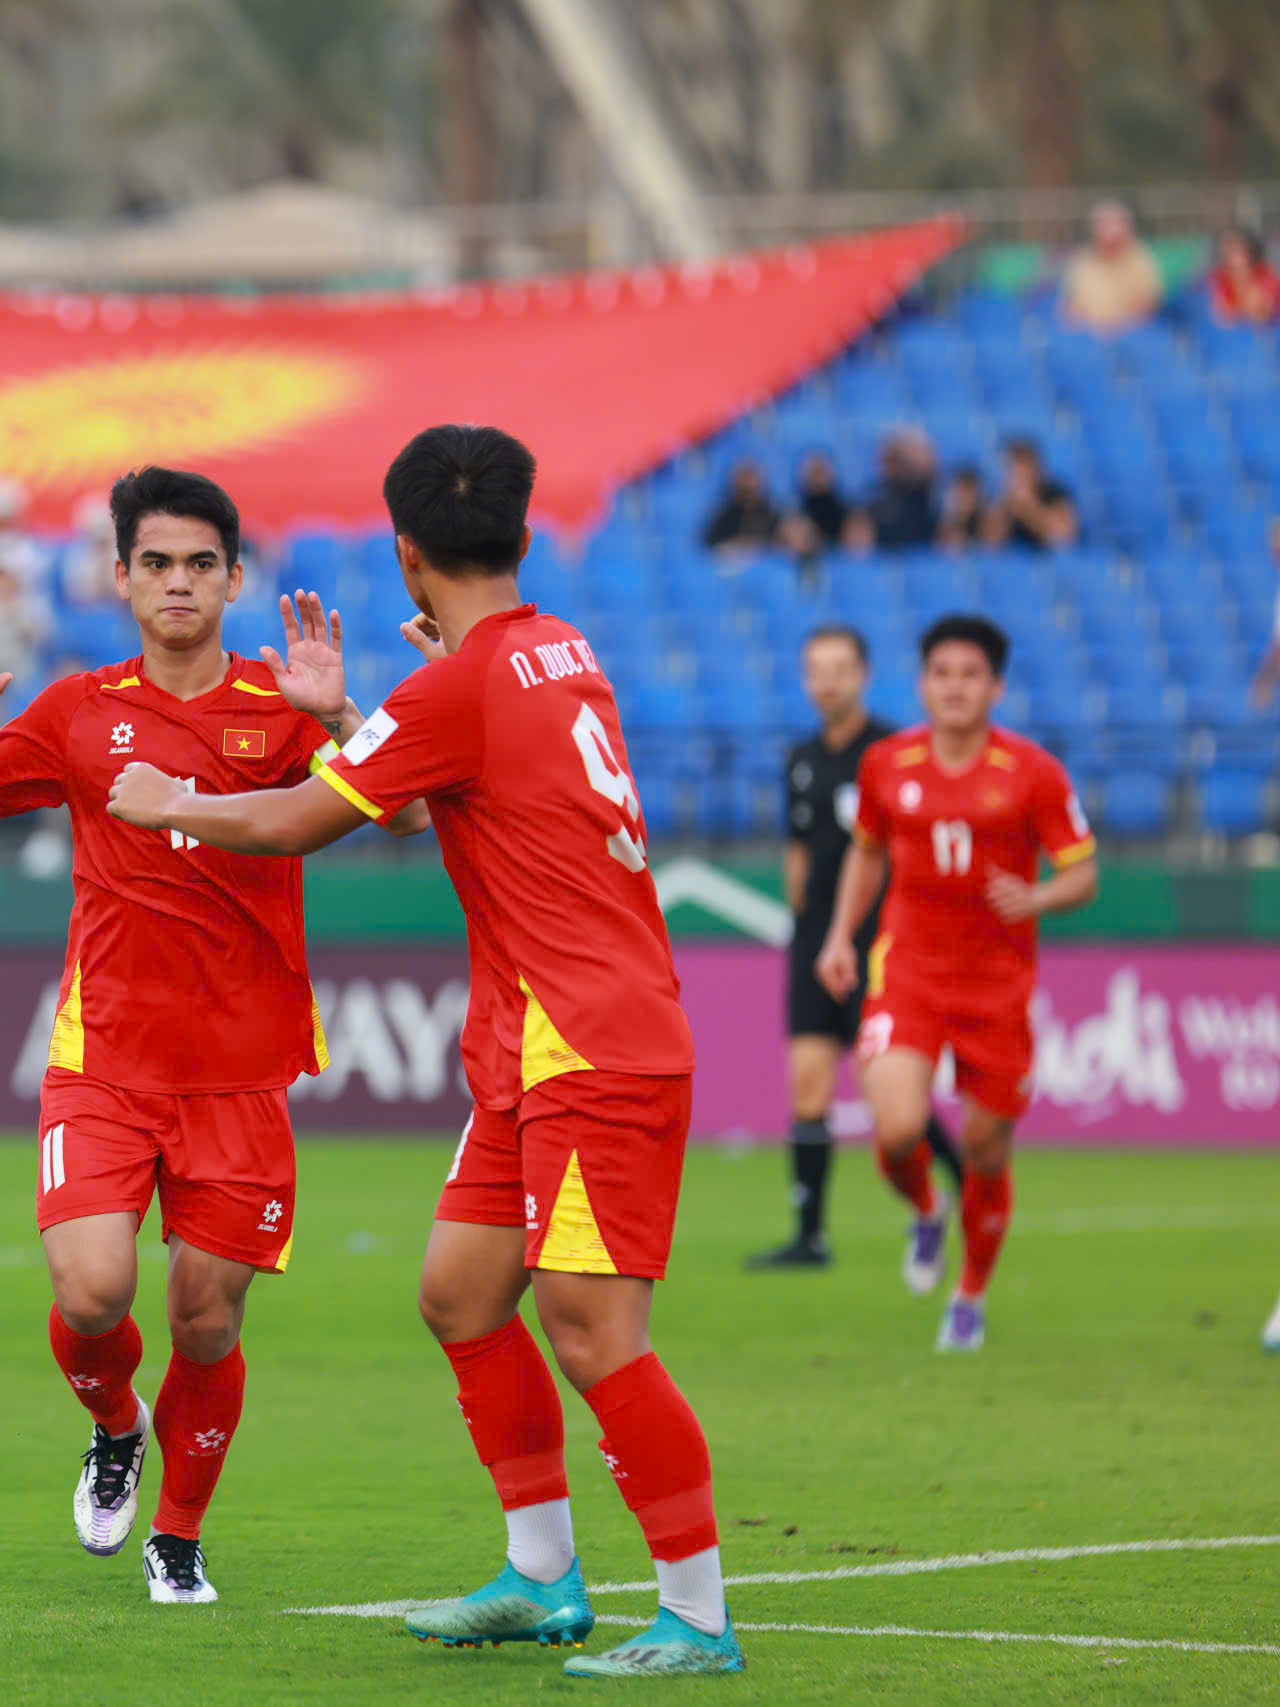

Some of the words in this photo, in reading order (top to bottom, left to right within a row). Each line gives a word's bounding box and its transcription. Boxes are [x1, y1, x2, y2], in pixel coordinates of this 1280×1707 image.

[571, 701, 647, 873] 9
[931, 818, 974, 877] 17
[43, 1122, 66, 1196] 11
